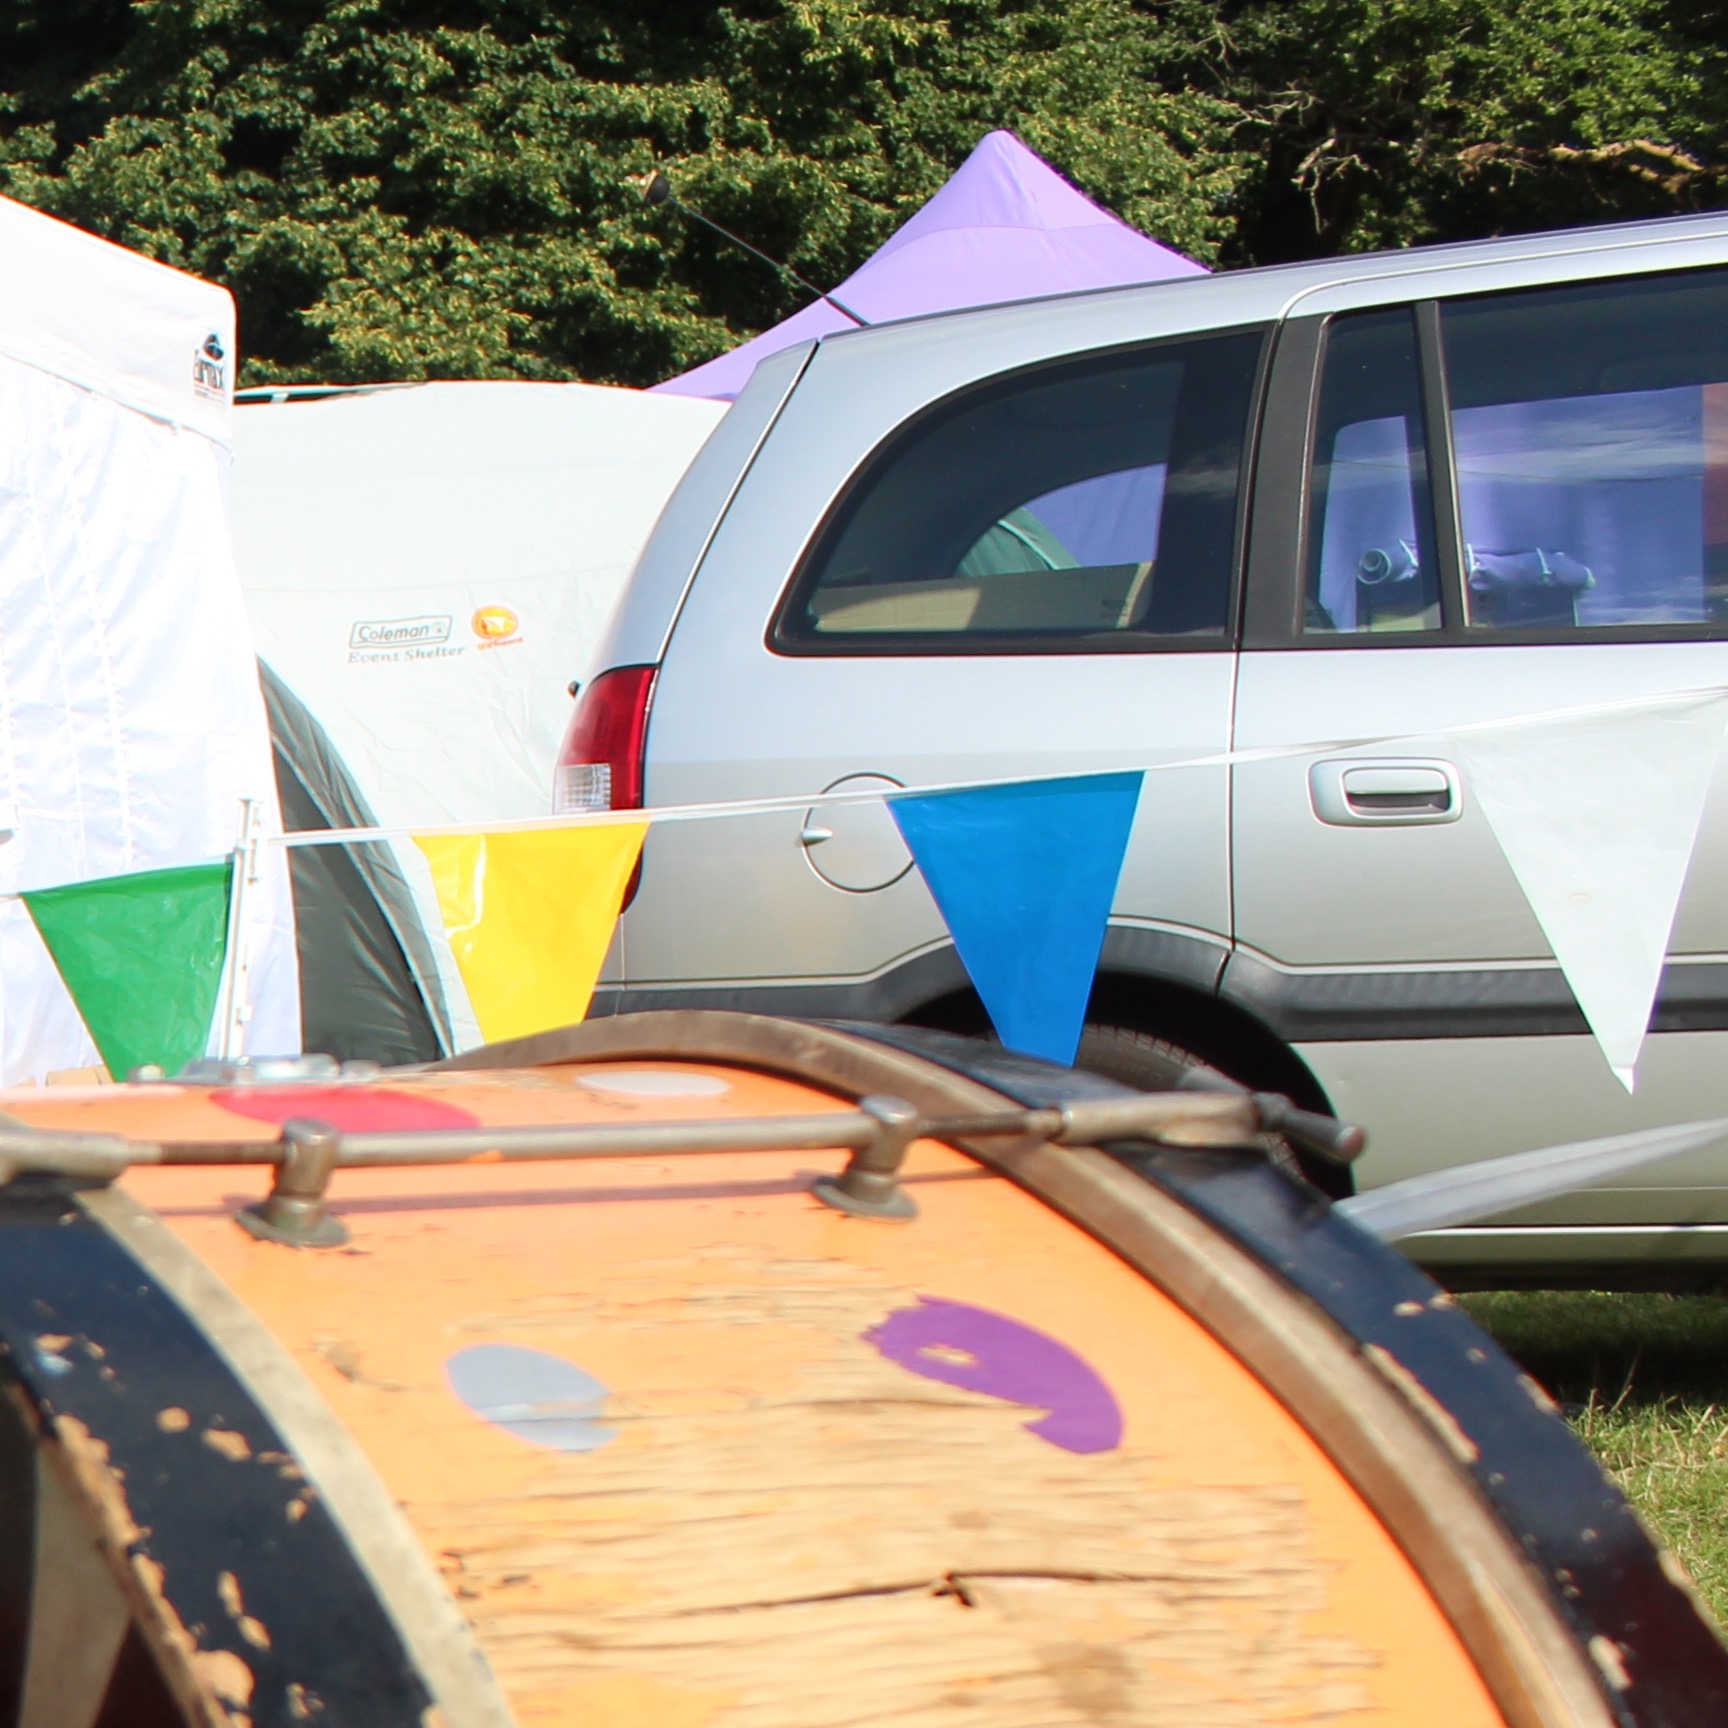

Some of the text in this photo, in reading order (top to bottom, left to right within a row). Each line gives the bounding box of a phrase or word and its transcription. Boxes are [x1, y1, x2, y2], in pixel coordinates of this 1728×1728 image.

[358, 625, 430, 642] Coleman
[347, 645, 466, 665] Event Shelter
